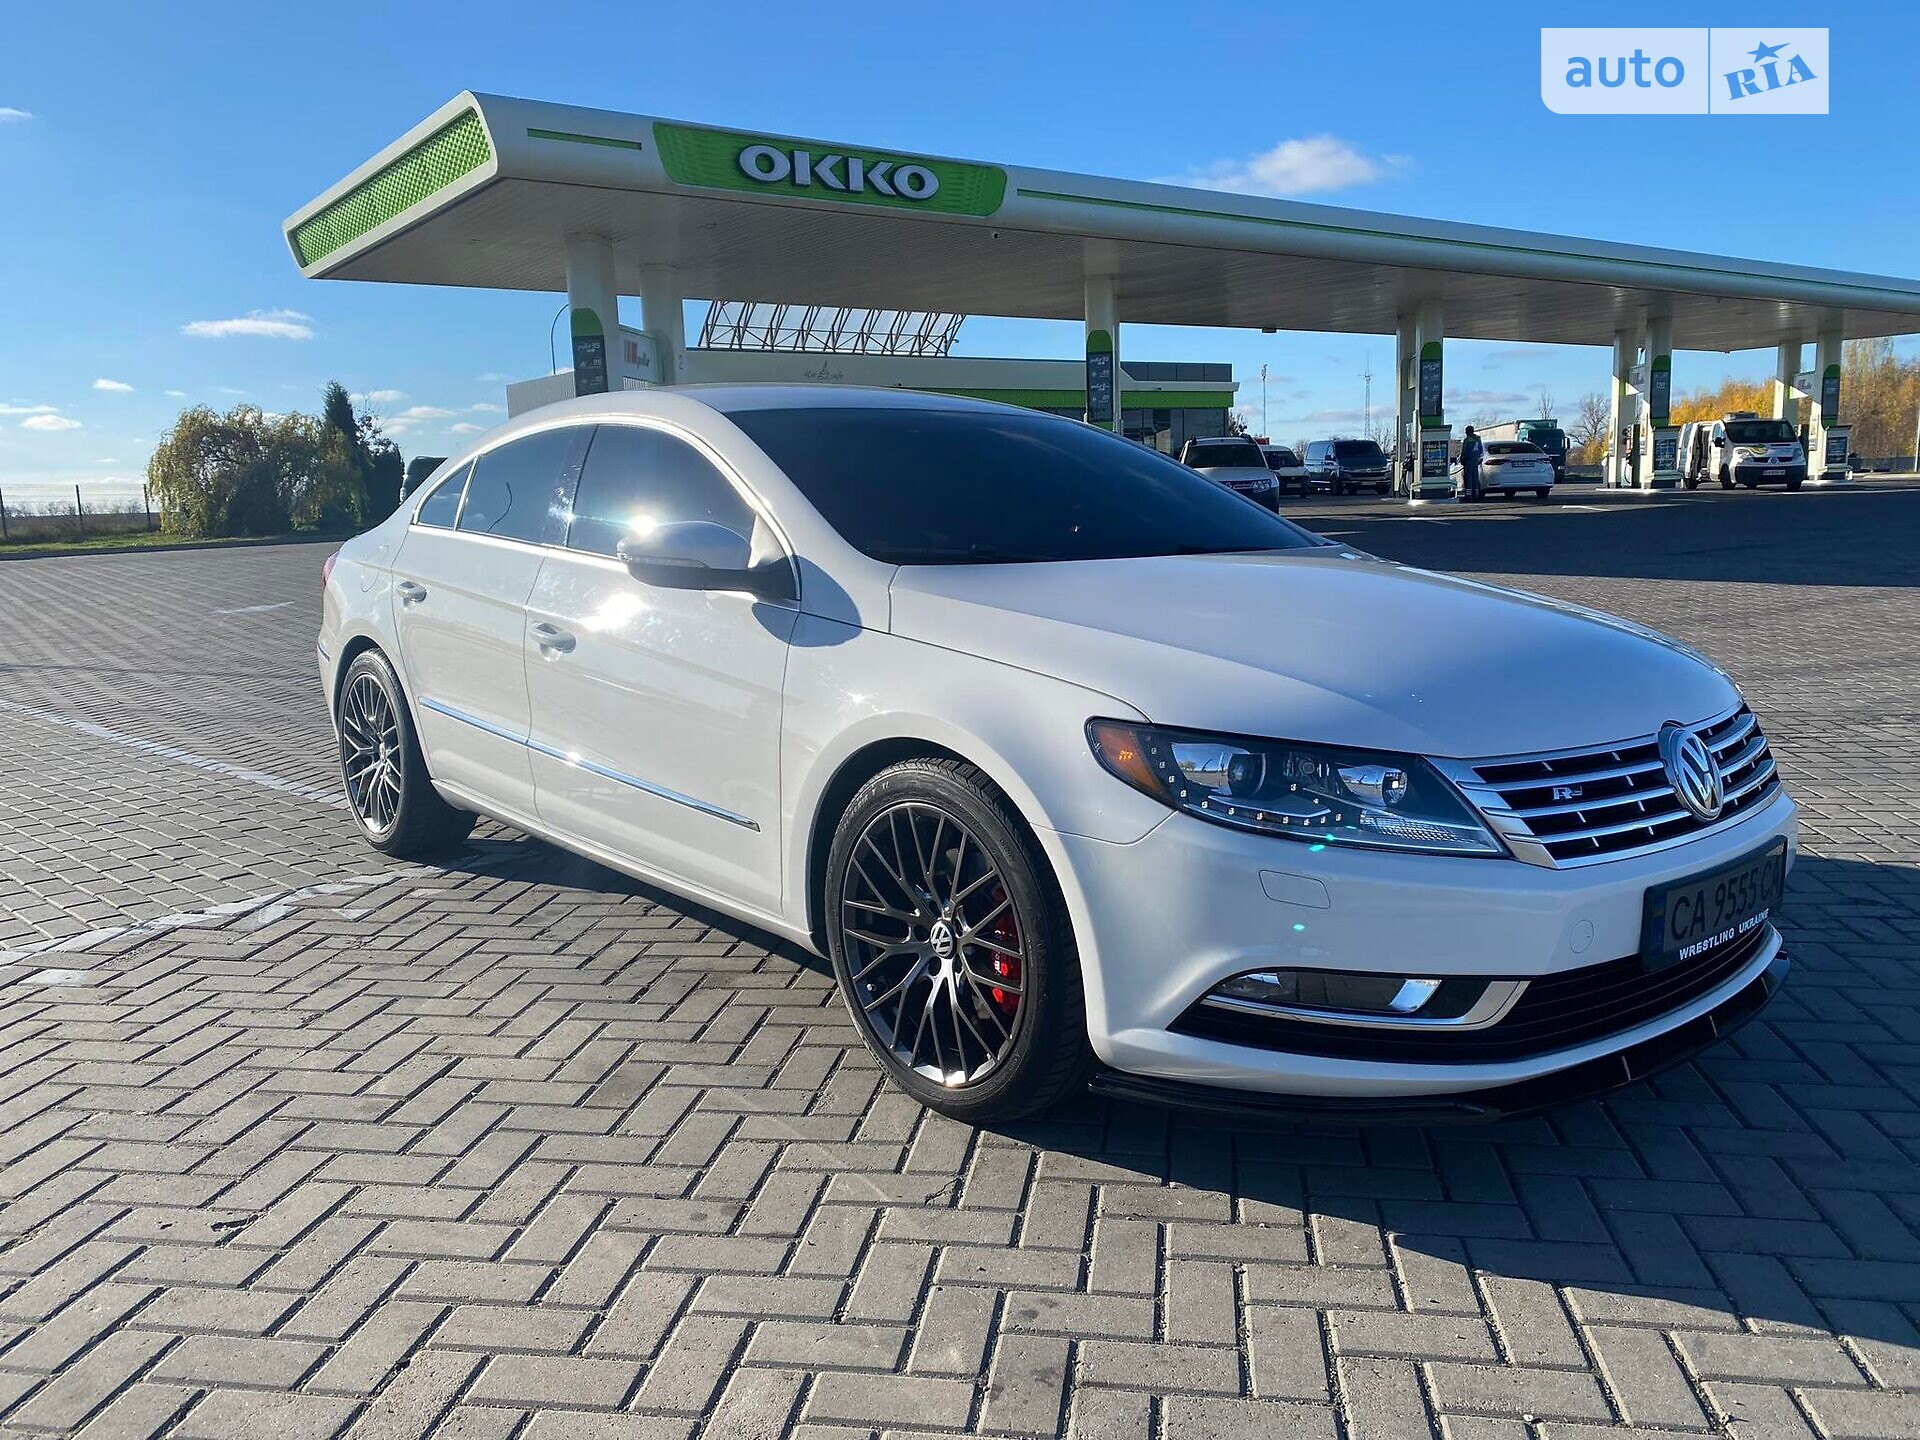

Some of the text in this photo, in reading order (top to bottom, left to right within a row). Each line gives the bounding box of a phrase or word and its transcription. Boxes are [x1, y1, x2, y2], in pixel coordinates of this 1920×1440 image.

[738, 144, 940, 200] OKKO
[1671, 890, 1706, 941] CA
[1713, 867, 1759, 928] 9555
[1679, 928, 1735, 961] WRESTLING
[1739, 908, 1770, 934] UKRAINE
